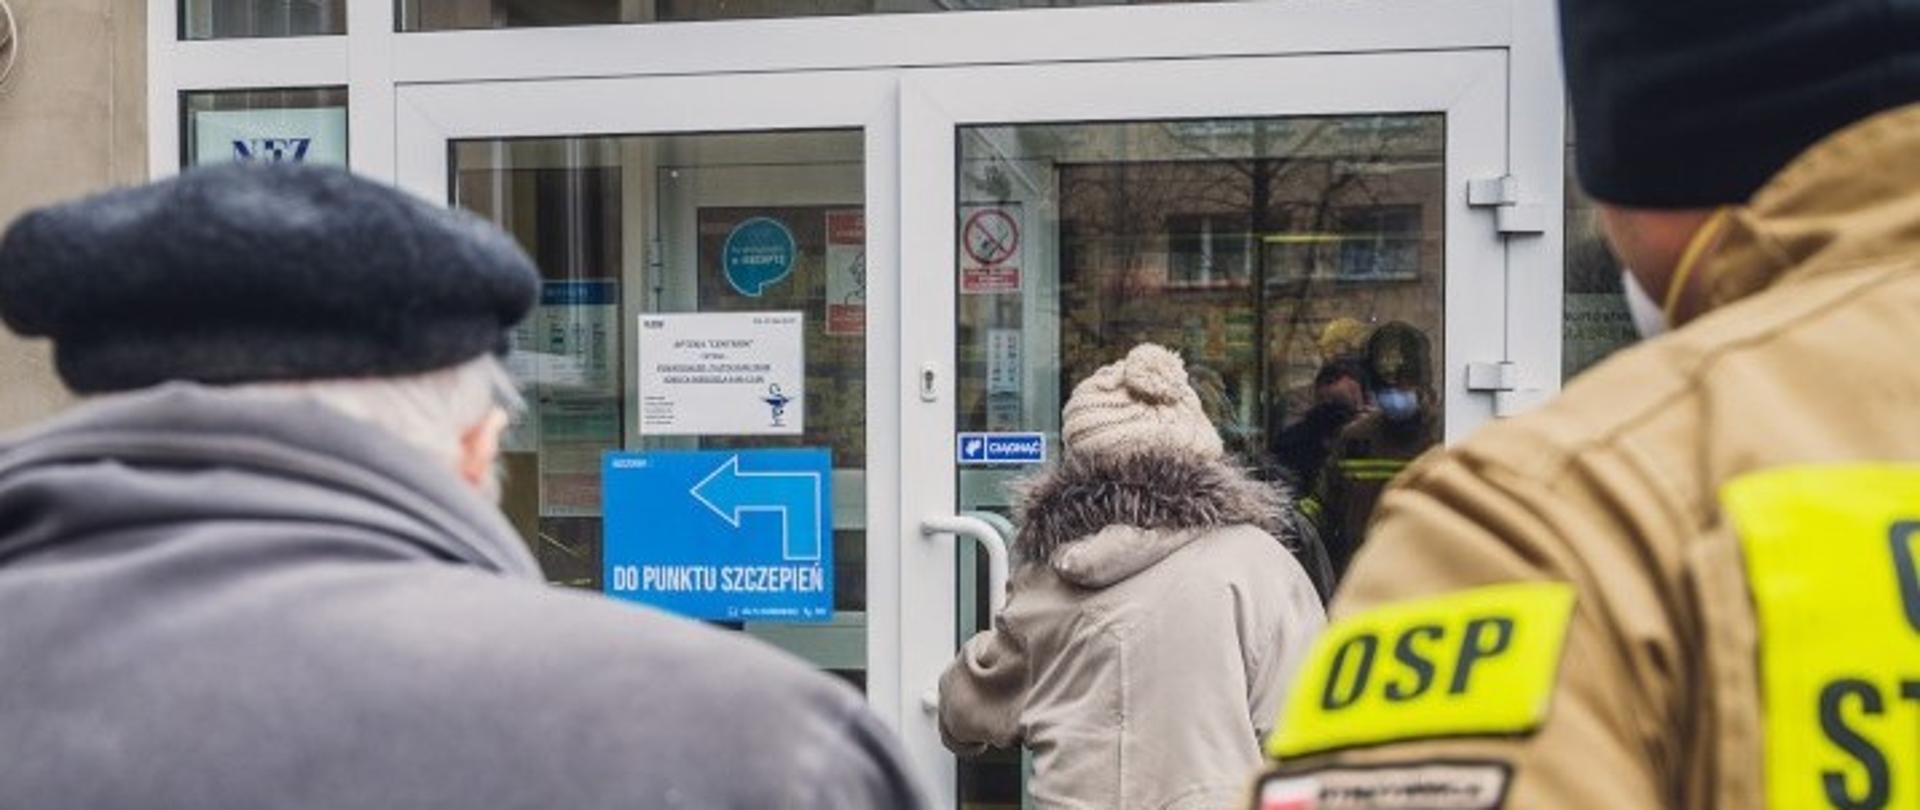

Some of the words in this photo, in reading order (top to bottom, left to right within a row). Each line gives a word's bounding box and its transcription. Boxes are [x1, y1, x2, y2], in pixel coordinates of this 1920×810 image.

[613, 566, 638, 591] DO
[643, 565, 716, 591] PUNKTU
[720, 562, 824, 592] SZCZEPIEŃ
[1320, 616, 1515, 712] OSP
